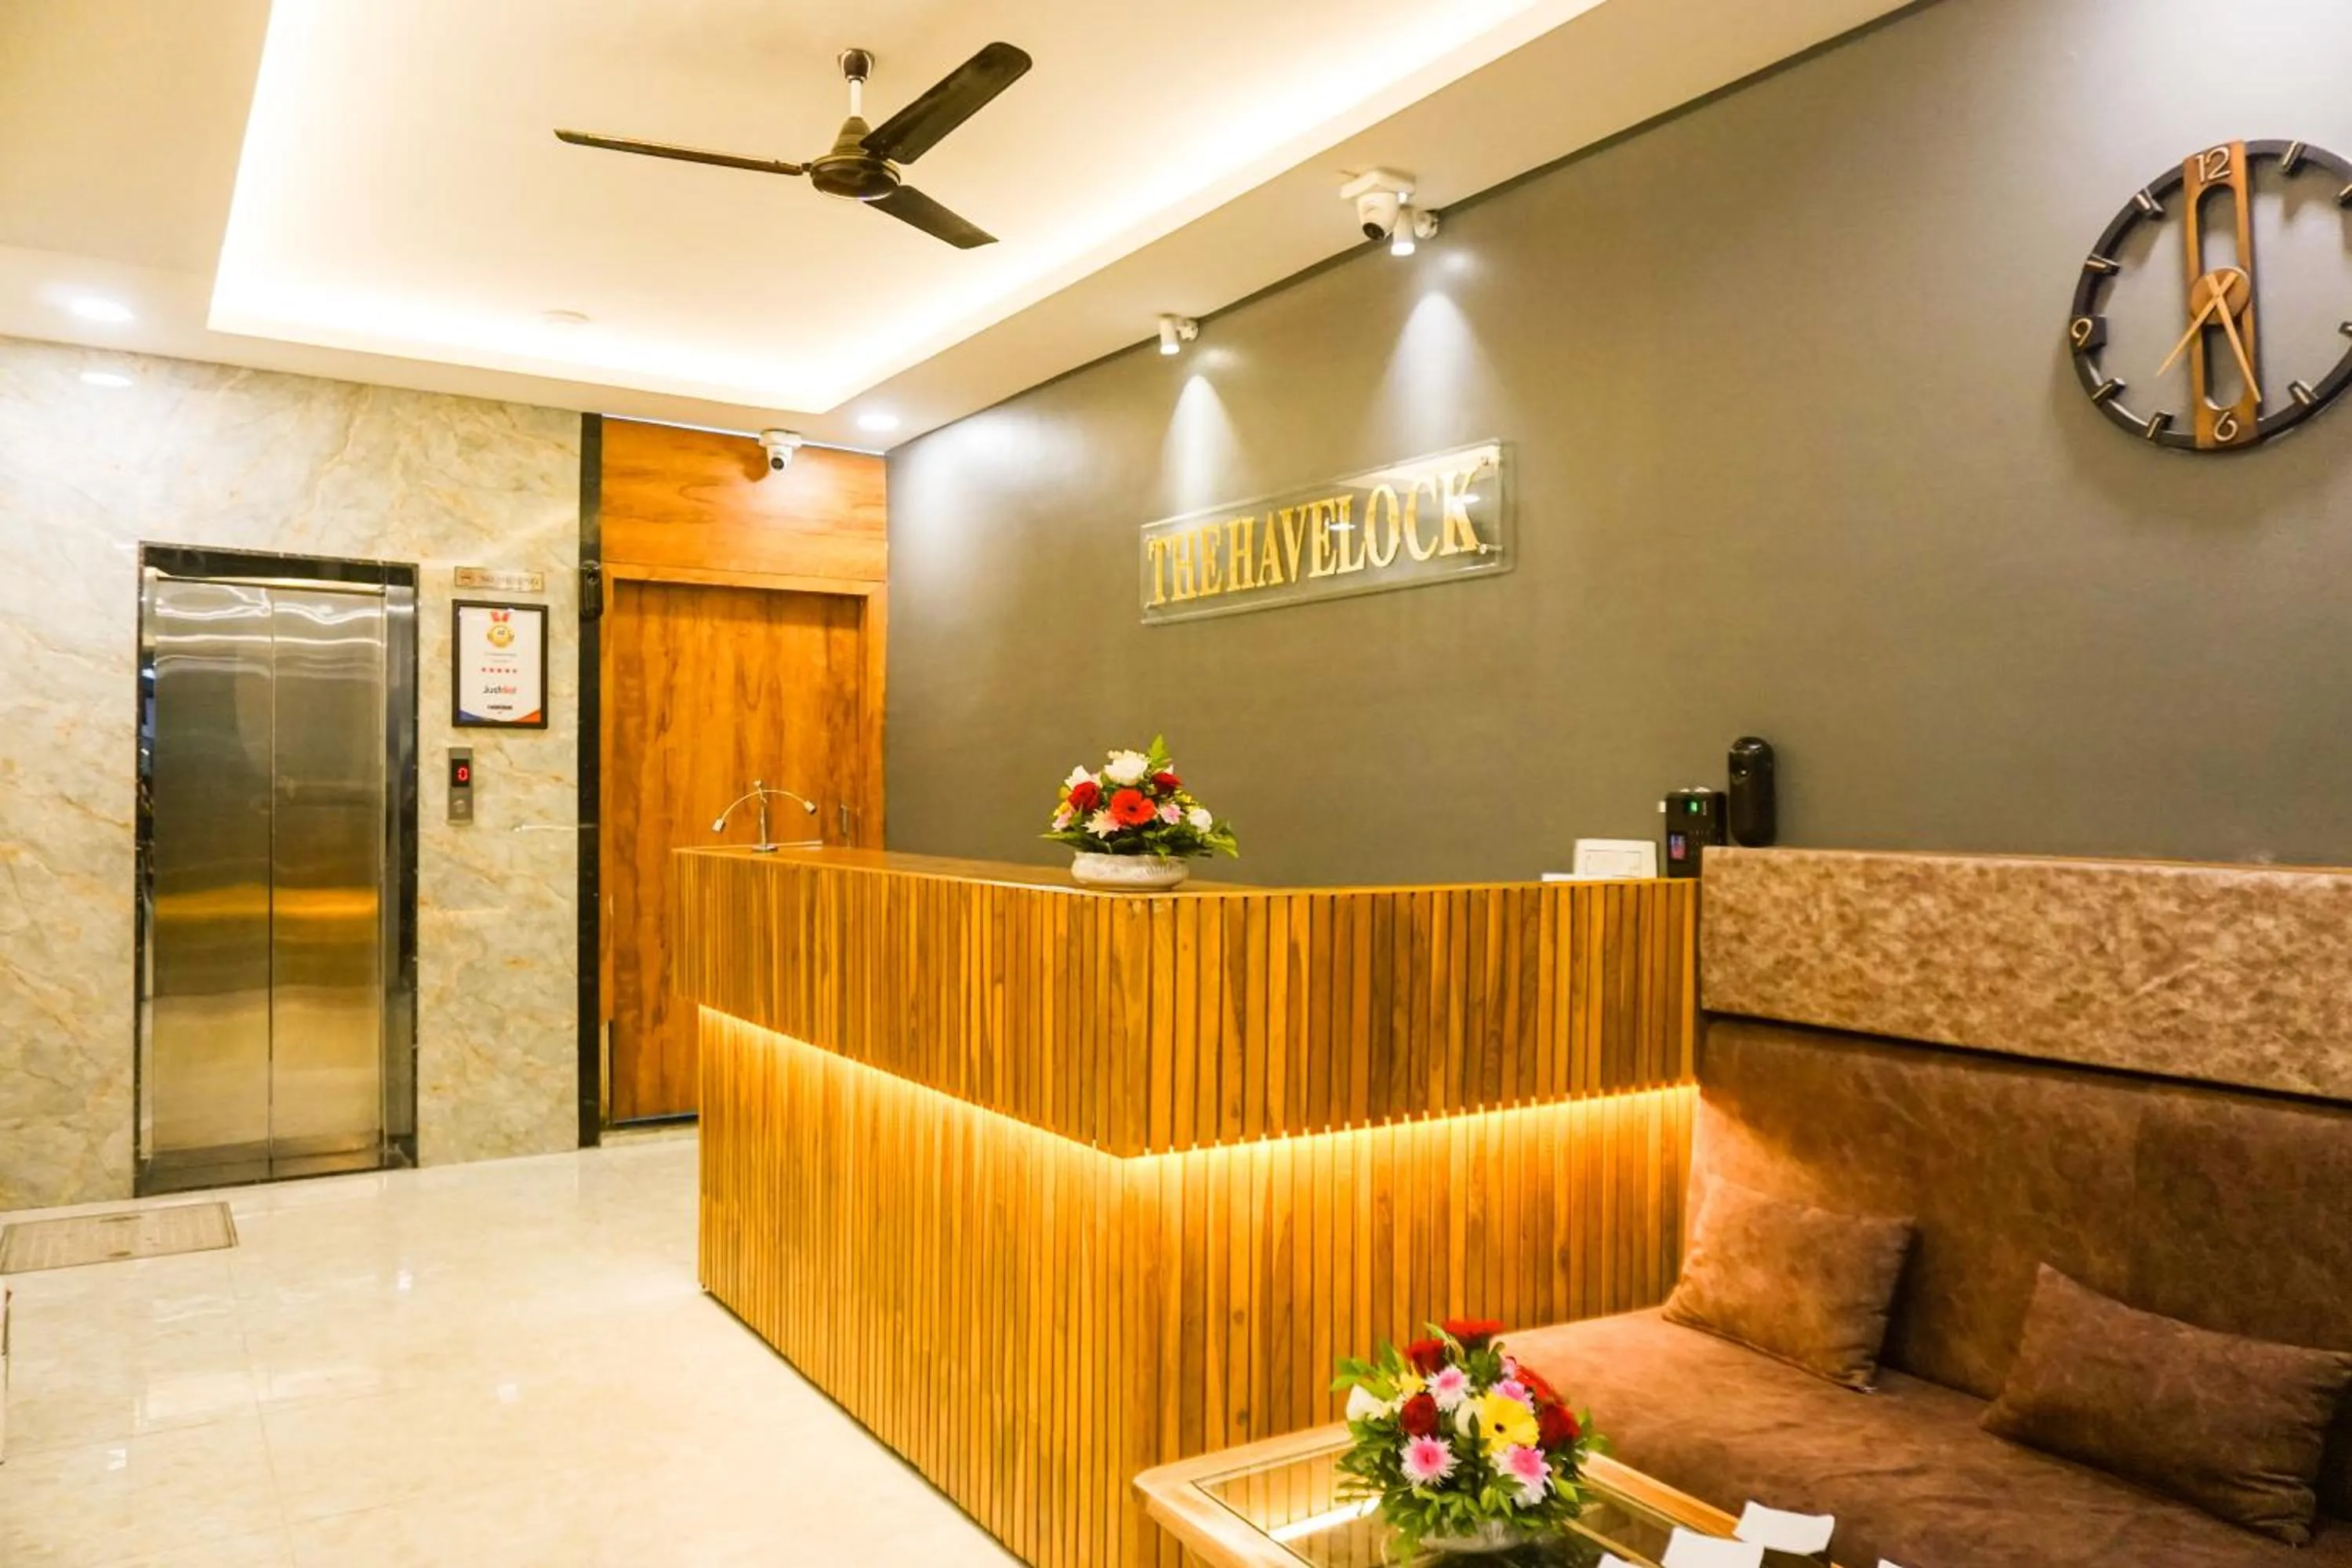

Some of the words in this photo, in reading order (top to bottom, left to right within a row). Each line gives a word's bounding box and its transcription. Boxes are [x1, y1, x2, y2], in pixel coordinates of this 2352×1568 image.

[2196, 146, 2233, 183] 12
[2071, 317, 2093, 347] 9
[2213, 412, 2238, 442] 6
[1148, 524, 1221, 603] THE
[457, 767, 469, 781] 0
